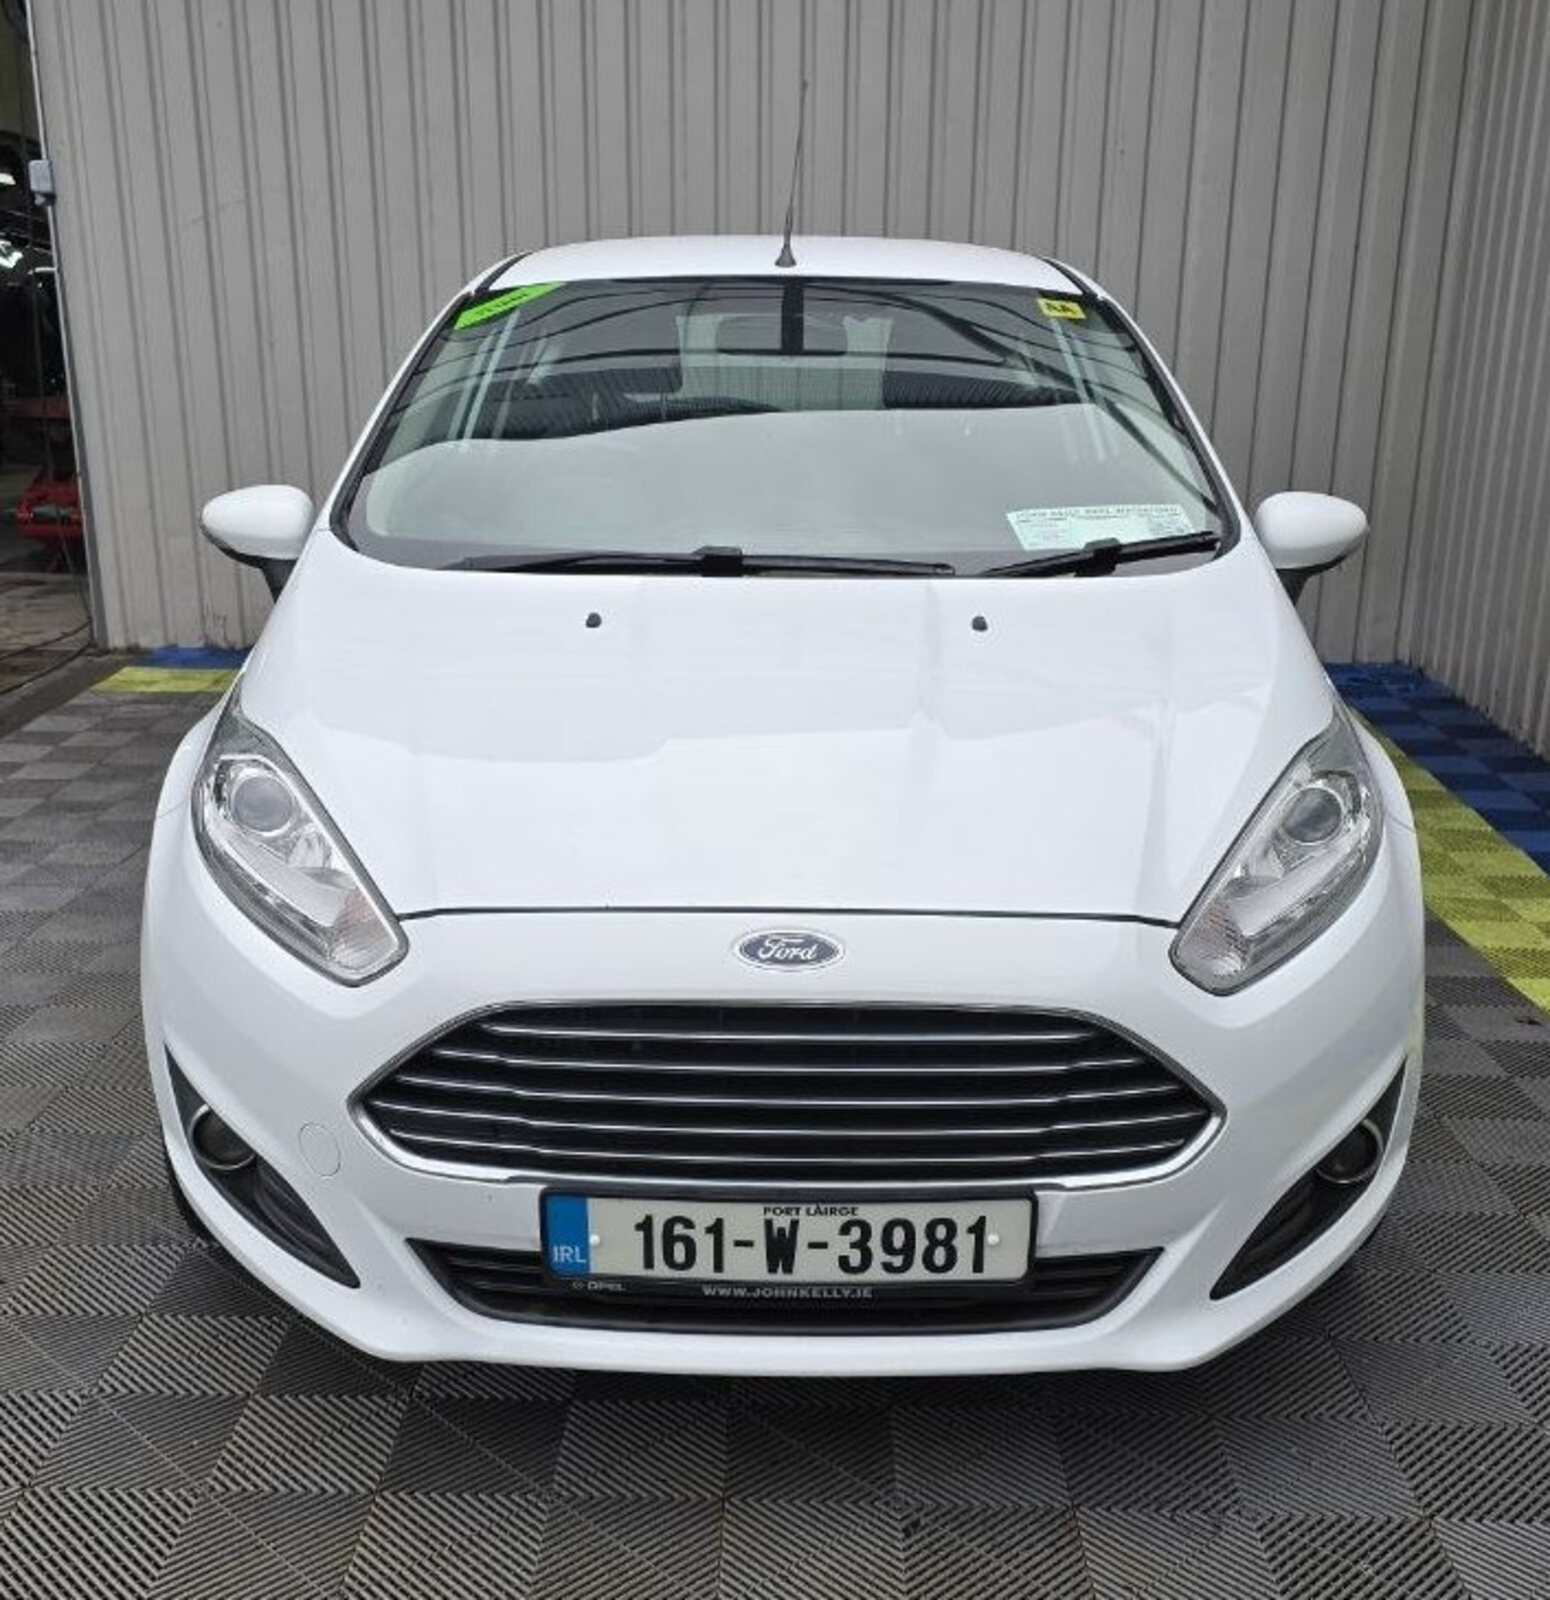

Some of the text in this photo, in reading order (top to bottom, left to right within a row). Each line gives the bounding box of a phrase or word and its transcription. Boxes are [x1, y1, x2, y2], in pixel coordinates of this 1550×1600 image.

[758, 935, 819, 959] Ford
[763, 1206, 800, 1217] PORT
[634, 1213, 986, 1276] 161-W-3981
[552, 1245, 587, 1264] IRL
[702, 1284, 873, 1299] WWW.JOHNKELLY.IE
